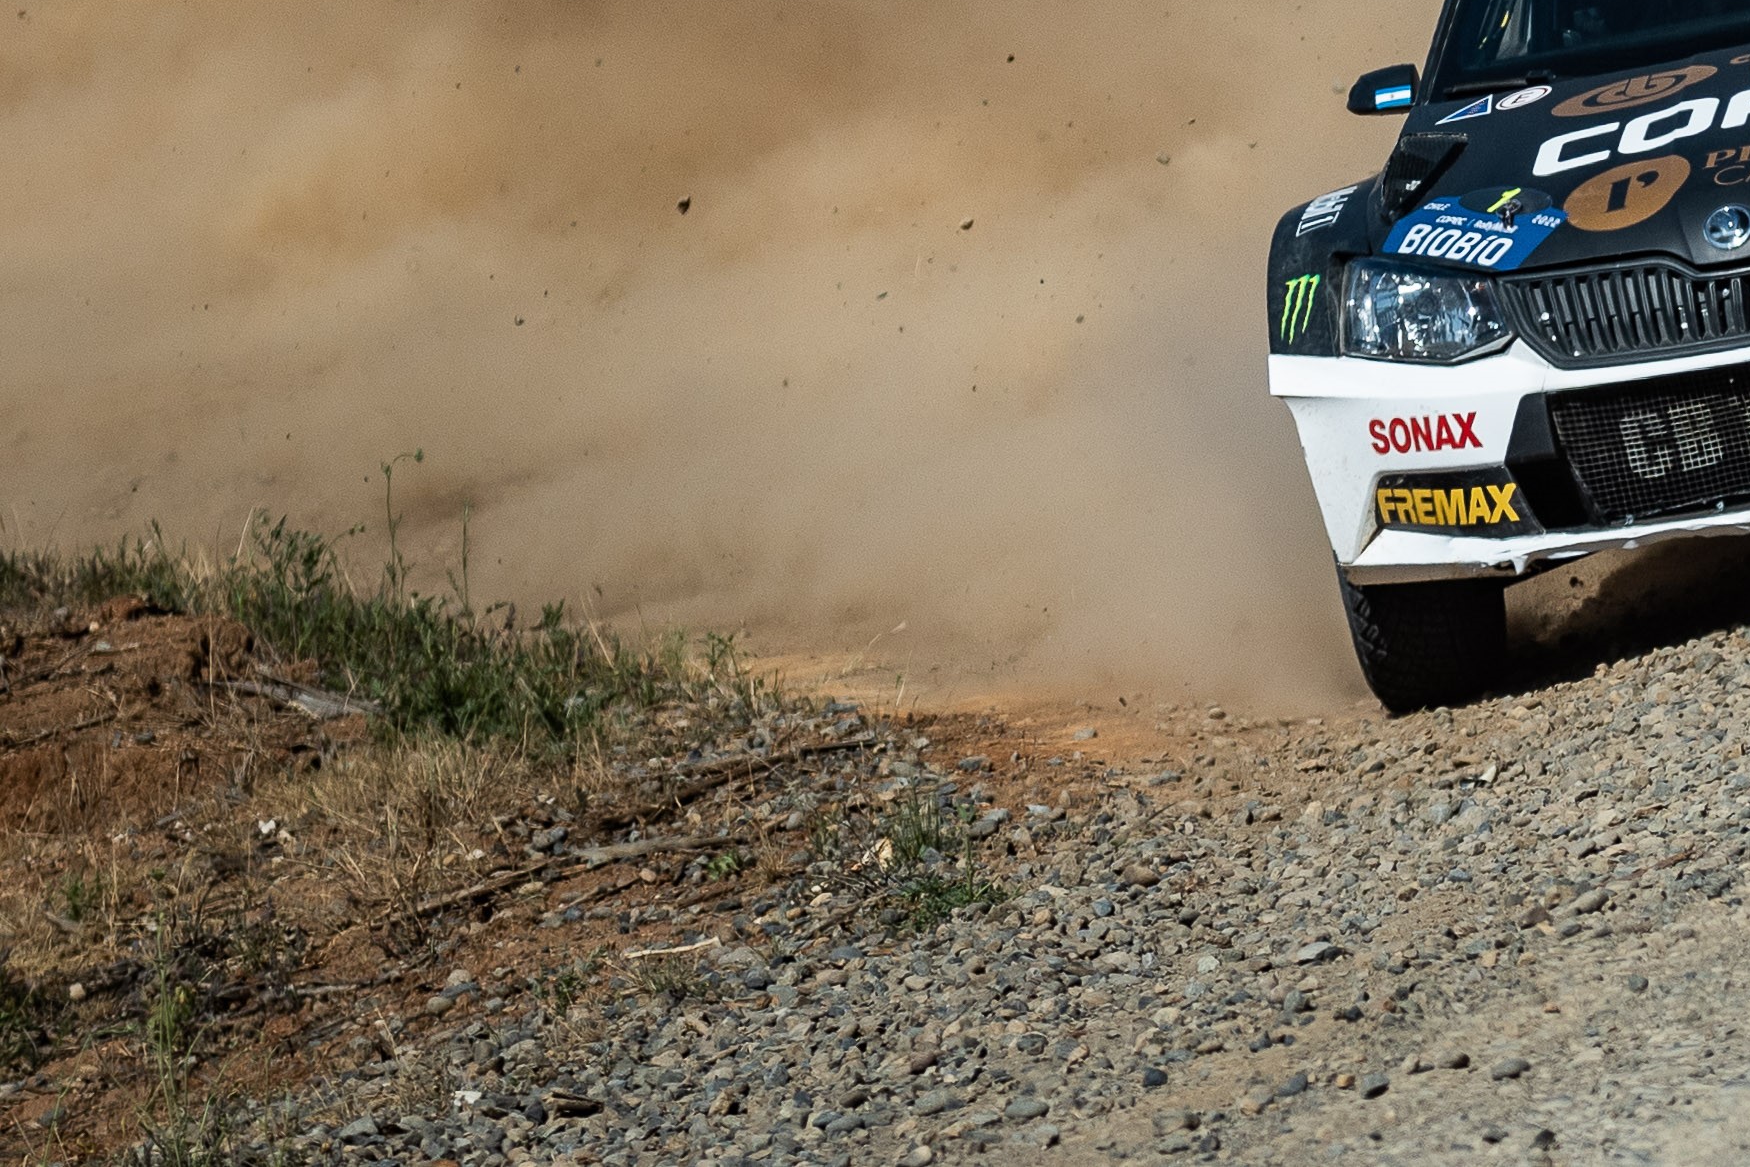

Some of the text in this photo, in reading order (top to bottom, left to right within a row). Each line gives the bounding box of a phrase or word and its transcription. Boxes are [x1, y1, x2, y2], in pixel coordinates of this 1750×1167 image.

[1531, 213, 1561, 229] 2022
[1368, 411, 1484, 456] SONAX
[1377, 482, 1521, 527] FREMAX
